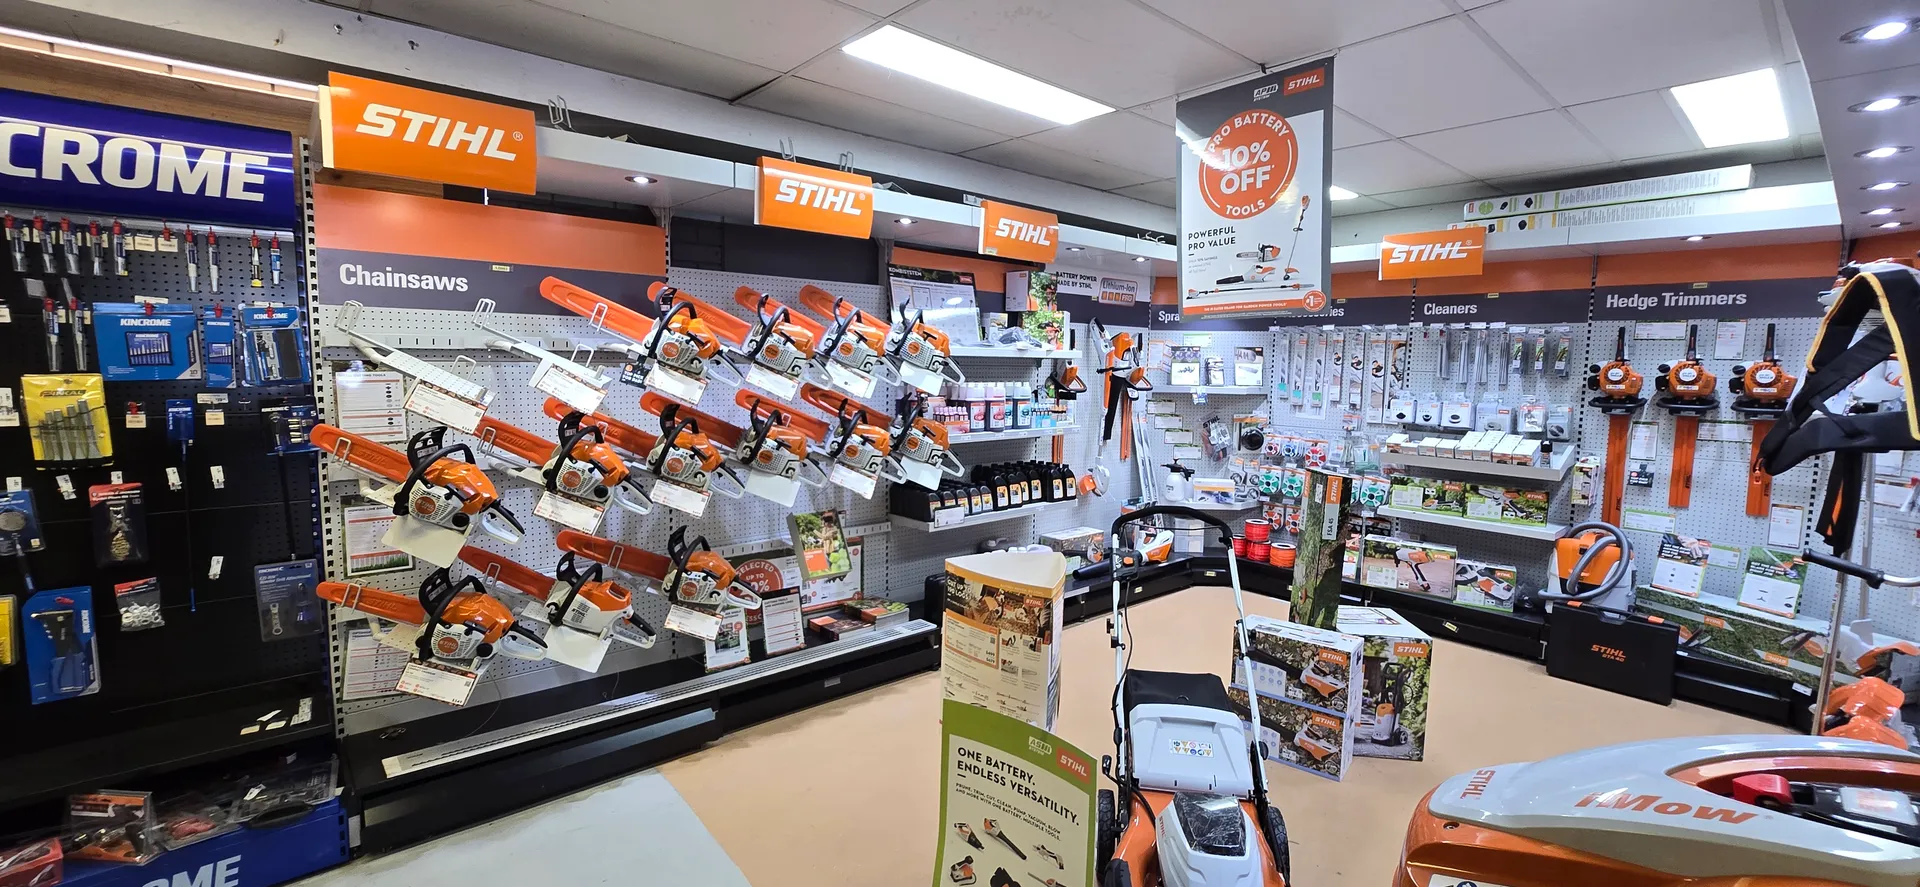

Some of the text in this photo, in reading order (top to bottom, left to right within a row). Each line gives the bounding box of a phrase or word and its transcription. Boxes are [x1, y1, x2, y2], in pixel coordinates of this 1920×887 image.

[1288, 75, 1320, 90] STIHL
[1208, 112, 1290, 153] PRO BATTERY
[1222, 139, 1271, 168] 10%
[775, 179, 861, 215] STIHL
[1226, 200, 1266, 216] TOOLS
[995, 217, 1051, 246] STIHL
[1188, 226, 1236, 241] POWERFUL
[1188, 236, 1236, 251] PRO VALUE
[1389, 241, 1468, 264] STIHL
[339, 263, 469, 292] Chainsaws
[1103, 280, 1136, 292] Lithium-Ion
[1424, 303, 1478, 315] Cleaners
[1606, 292, 1747, 310] Hedge Trimmers
[120, 319, 171, 327] KINCROME
[1203, 415, 1220, 428] STIHL
[1331, 479, 1339, 502] STIHL
[735, 561, 774, 577] SELECTED
[1322, 653, 1344, 662] STIHL
[1397, 646, 1424, 655] STIHL
[1591, 644, 1626, 658] STIHL
[1315, 716, 1337, 727] STIHL
[958, 747, 1036, 785] ONE BATTERY.
[1060, 755, 1087, 777] STIHL
[957, 760, 1080, 826] ENDLESS VERSATILITY.
[1460, 769, 1497, 800] STIHL
[956, 783, 972, 792] PRUNE,
[973, 789, 985, 797] TRIM,
[986, 794, 996, 802] CUT,
[997, 799, 1013, 810] CLEAN,
[1013, 807, 1027, 817] PUMP,
[1048, 825, 1061, 834] BLOW
[966, 792, 979, 800] MORE
[980, 797, 991, 805] WITH
[992, 802, 1001, 810] ONE
[1003, 807, 1022, 820] BATTERY,
[1023, 817, 1044, 831] MULTIPLE
